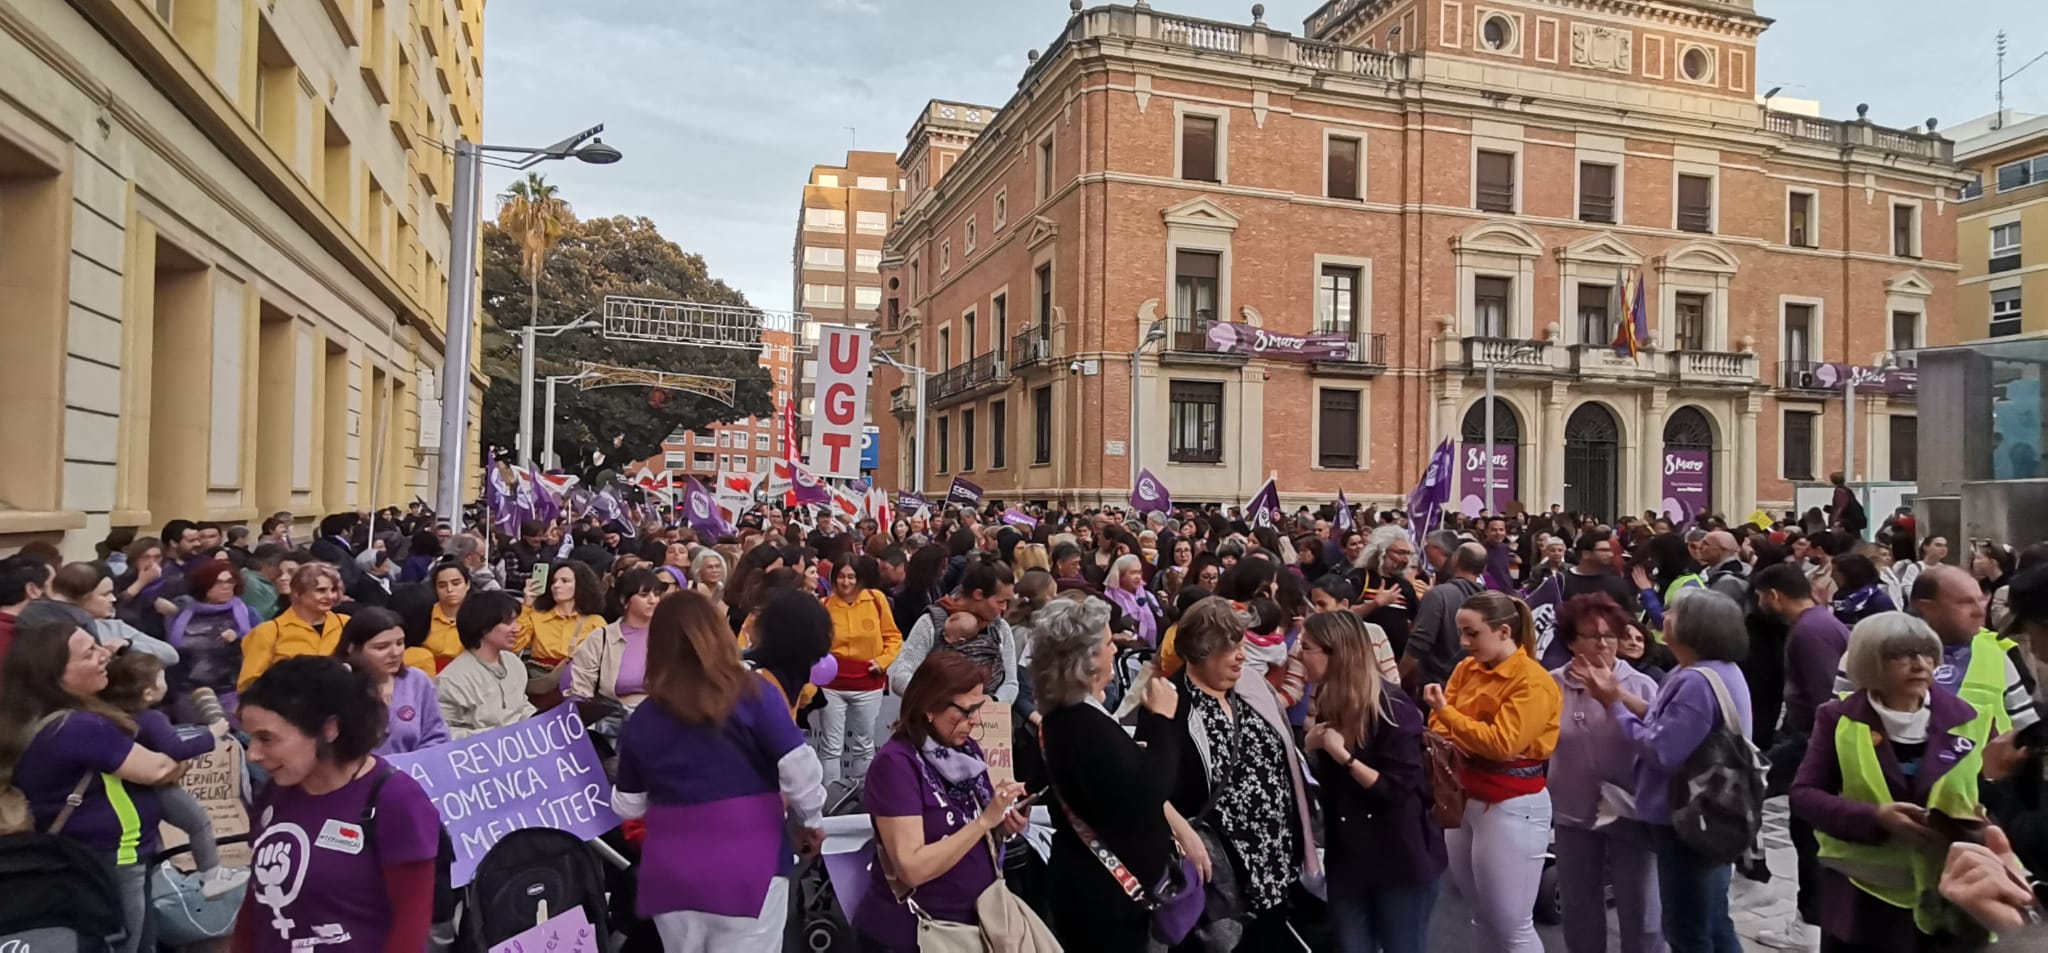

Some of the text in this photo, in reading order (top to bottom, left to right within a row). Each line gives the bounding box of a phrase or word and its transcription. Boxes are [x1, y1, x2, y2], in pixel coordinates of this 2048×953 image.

[1253, 330, 1268, 352] 8
[822, 332, 860, 473] UGT
[1466, 447, 1478, 471] 8
[1664, 454, 1675, 475] 8
[410, 763, 434, 788] A
[556, 751, 591, 782] AL
